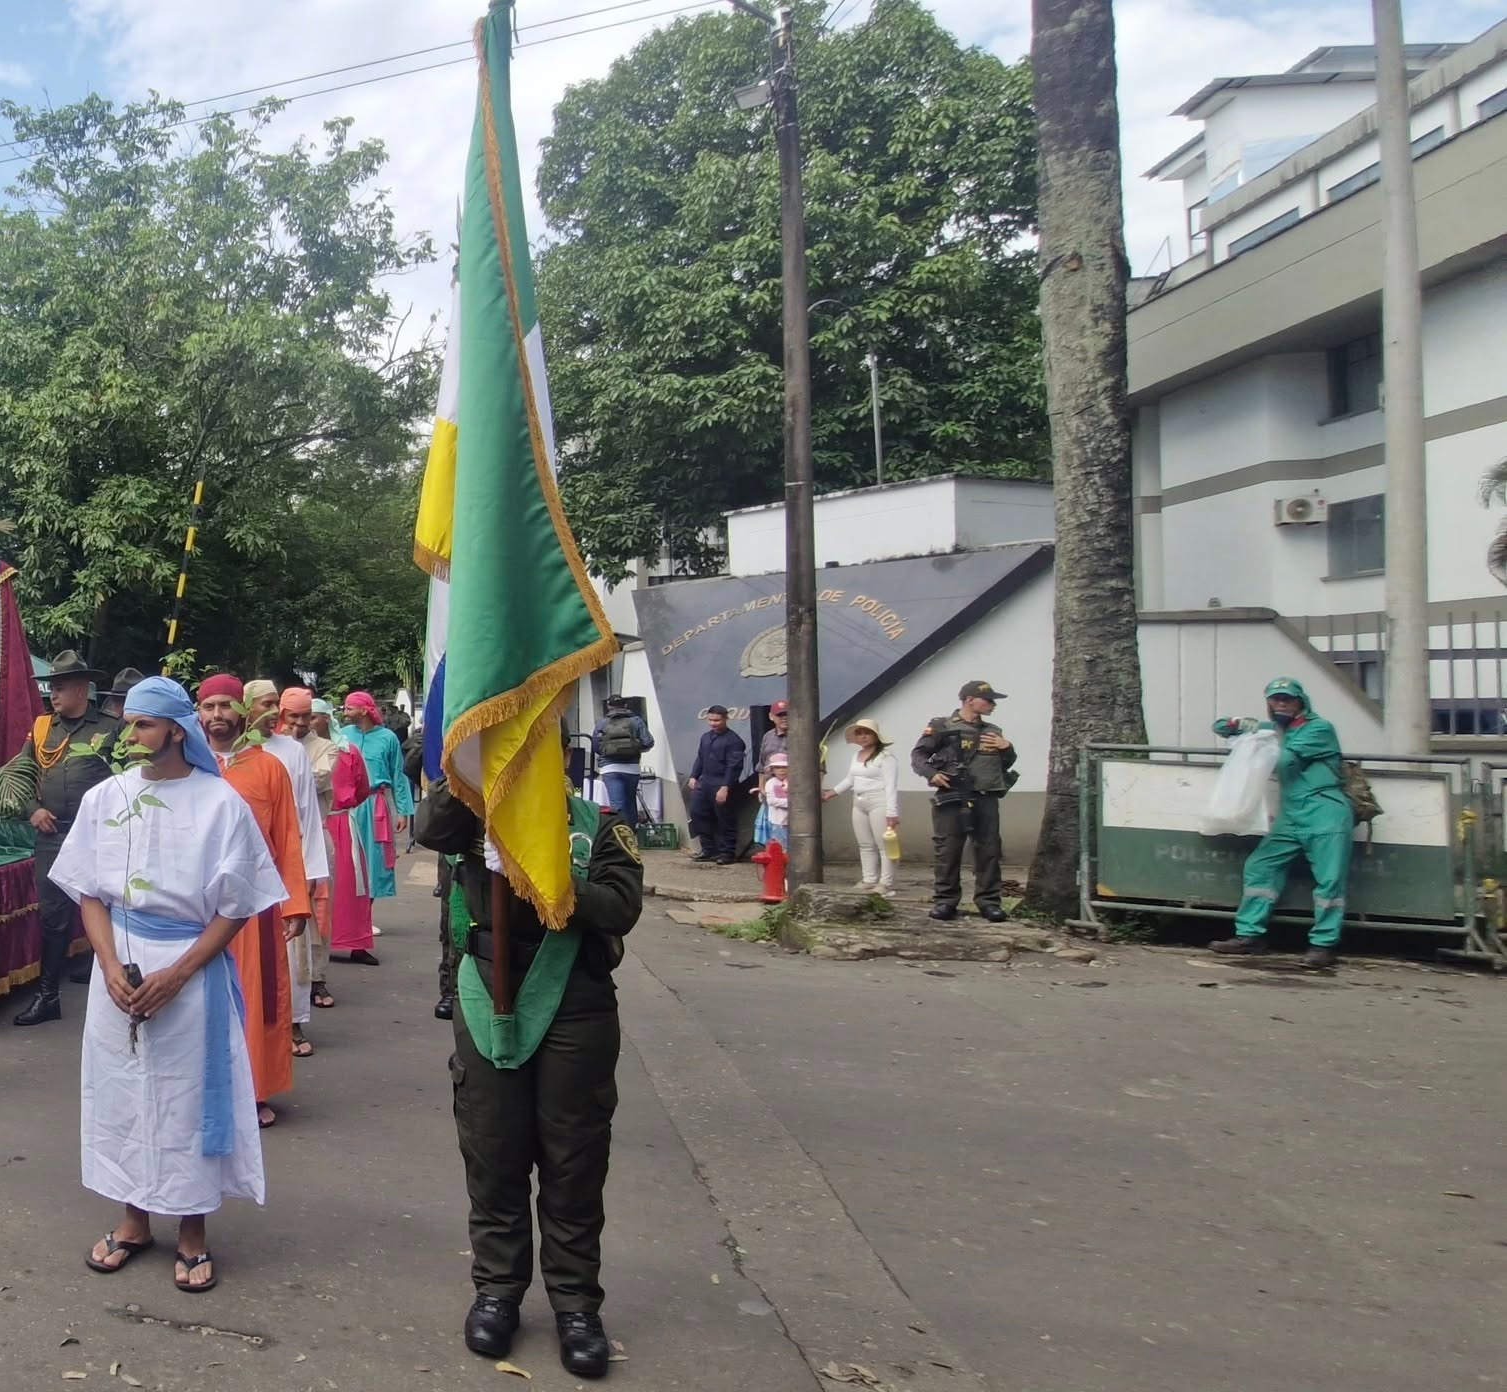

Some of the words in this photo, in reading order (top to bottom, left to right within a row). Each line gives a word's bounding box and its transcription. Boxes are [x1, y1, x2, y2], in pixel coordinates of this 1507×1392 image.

[661, 592, 786, 656] DEPARTAMEN
[817, 590, 845, 602] DE
[849, 594, 909, 641] POLICÍA
